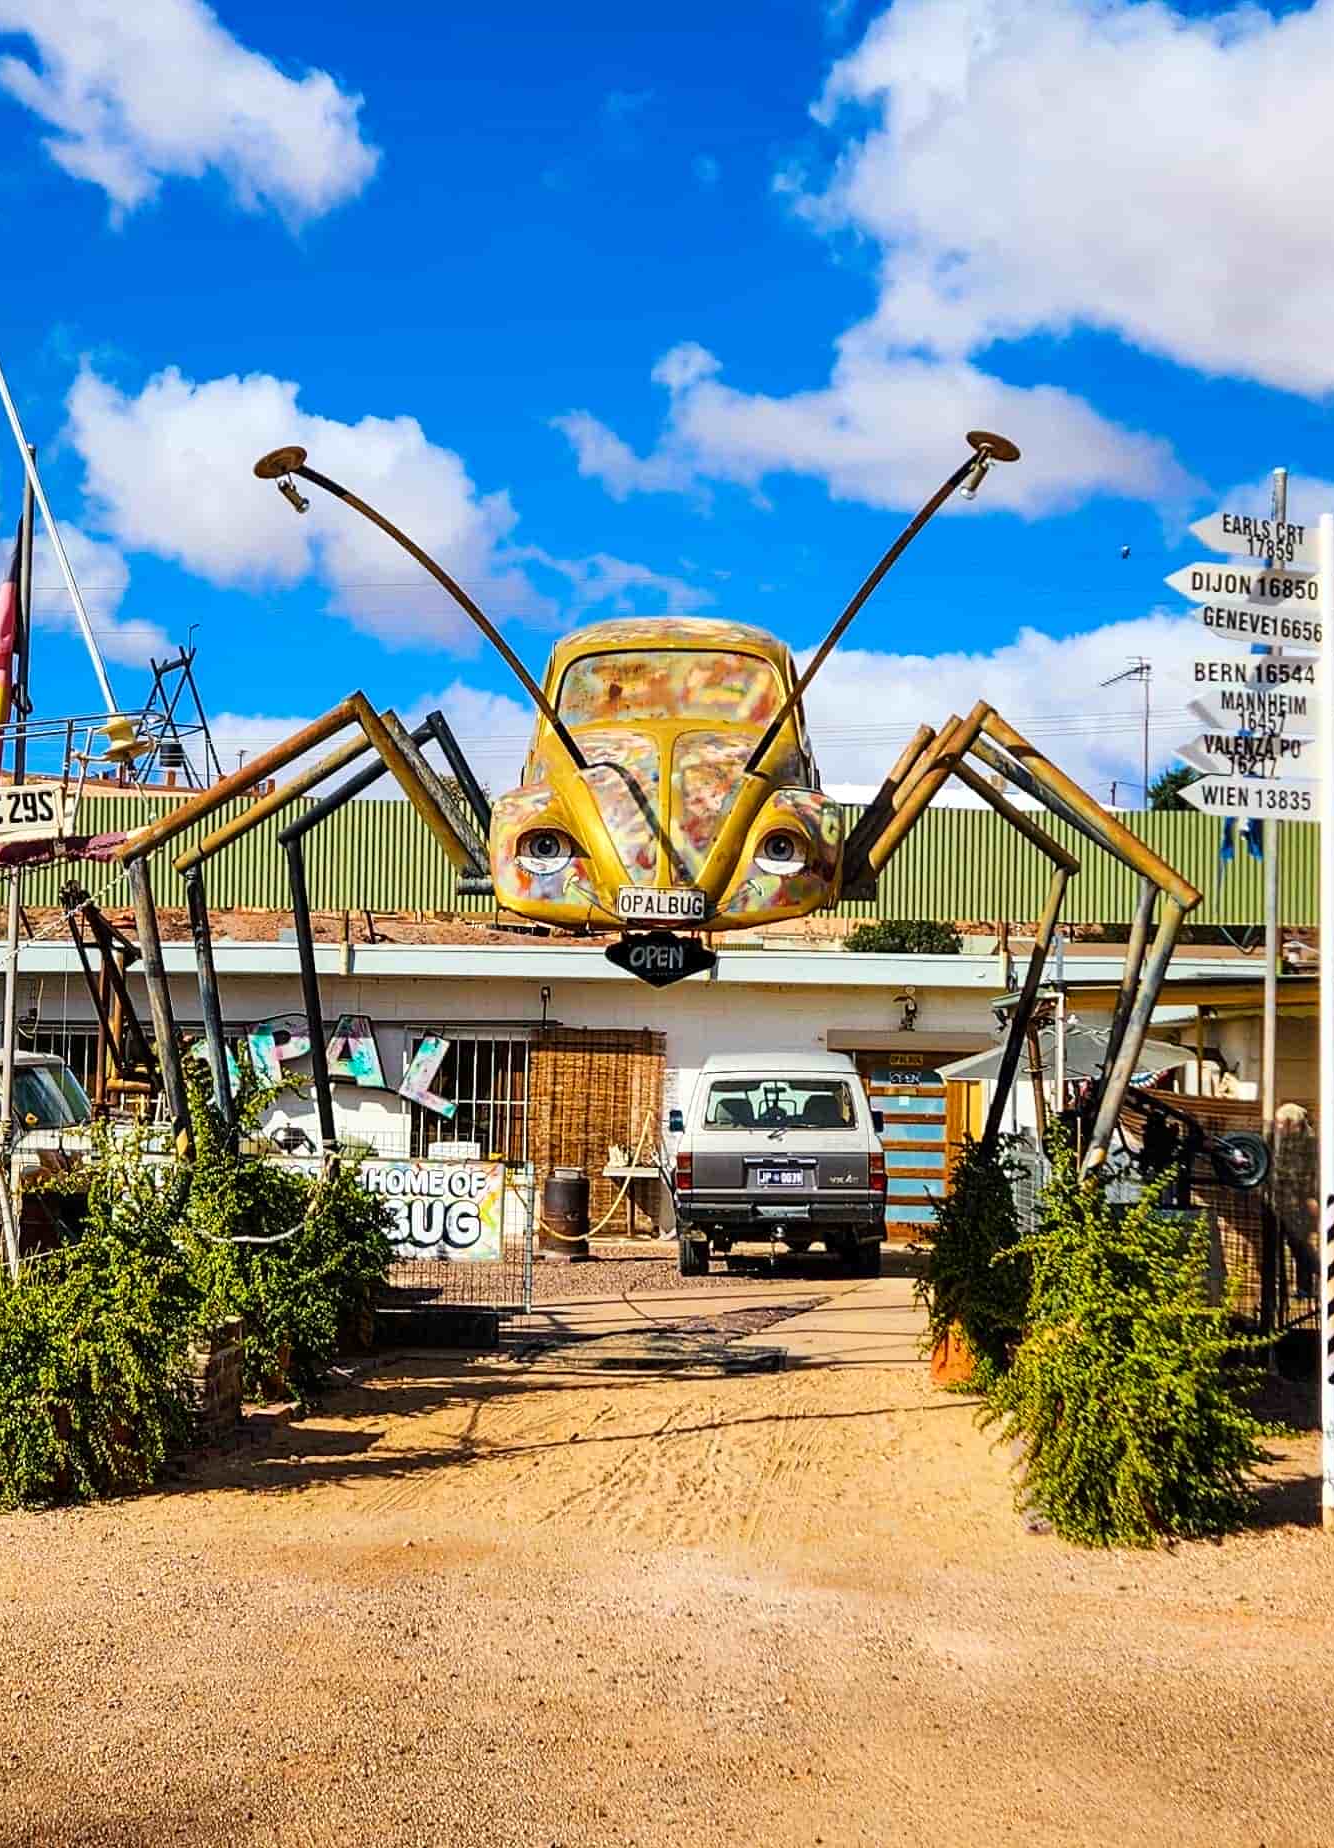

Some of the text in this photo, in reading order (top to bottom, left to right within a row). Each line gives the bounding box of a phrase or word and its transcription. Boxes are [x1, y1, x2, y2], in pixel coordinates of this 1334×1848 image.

[1223, 512, 1305, 545] EARLS CRT
[1247, 535, 1294, 562] 17859
[1192, 571, 1319, 600] DIJON 16850
[1194, 662, 1315, 685] BERN 16544
[1221, 690, 1307, 715] MANNHEIM
[1203, 734, 1301, 759] VALENZA PO
[1201, 784, 1312, 811] WIEN 13835
[620, 894, 704, 915] OPALBUG
[629, 944, 685, 970] OPEN
[367, 1167, 444, 1198] HOME
[448, 1169, 489, 1199] OF
